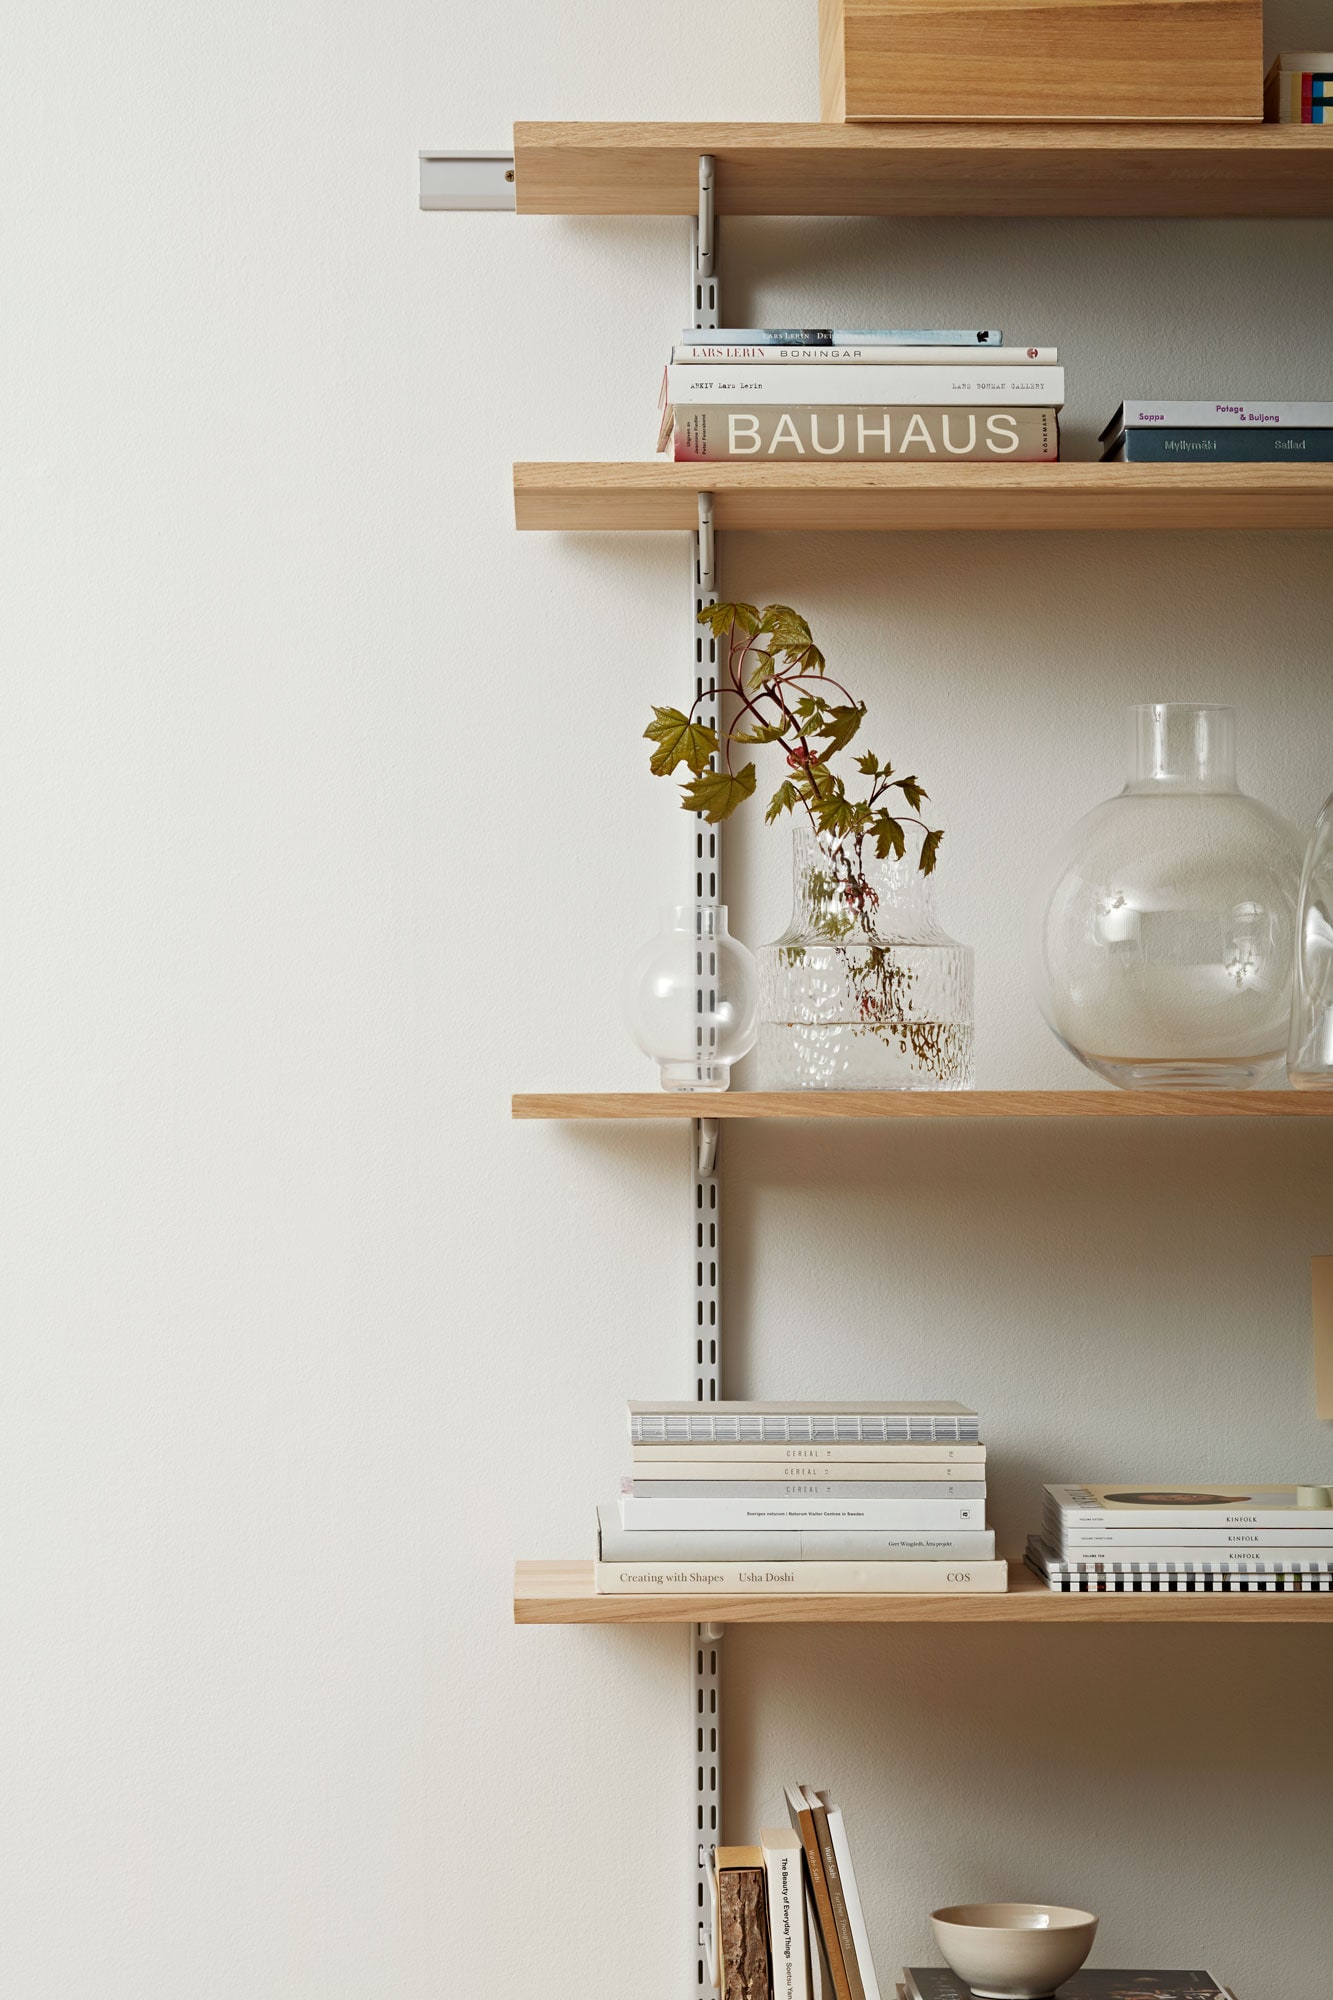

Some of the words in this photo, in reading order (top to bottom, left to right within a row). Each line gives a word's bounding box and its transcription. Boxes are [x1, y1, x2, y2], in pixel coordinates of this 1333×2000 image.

[692, 347, 723, 358] LARS
[726, 347, 766, 358] LERIN
[780, 350, 862, 358] BONINGAR
[690, 382, 714, 390] ARKIV
[718, 382, 736, 390] Lars
[740, 382, 763, 390] Lerin
[1216, 404, 1244, 414] Potage
[1138, 412, 1165, 422] Soppa
[1249, 413, 1280, 423] Buljong
[728, 413, 1019, 455] BAUHAUS
[1164, 439, 1218, 453] Myllymäki
[1274, 439, 1306, 450] Sallad
[1229, 1552, 1261, 1560] KINFOLK
[619, 1572, 664, 1584] Creating
[666, 1572, 688, 1582] with
[689, 1572, 725, 1584] Shapes
[739, 1572, 763, 1582] Usha
[765, 1572, 795, 1582] Doshi
[946, 1572, 971, 1583] COS
[808, 1850, 820, 1883] Wabi-Sabi
[824, 1846, 836, 1879] Wabi-Sabi
[781, 1872, 789, 1896] Beauty
[783, 1896, 789, 1904] of
[783, 1905, 791, 1936] Everyday
[784, 1937, 792, 1959] Things
